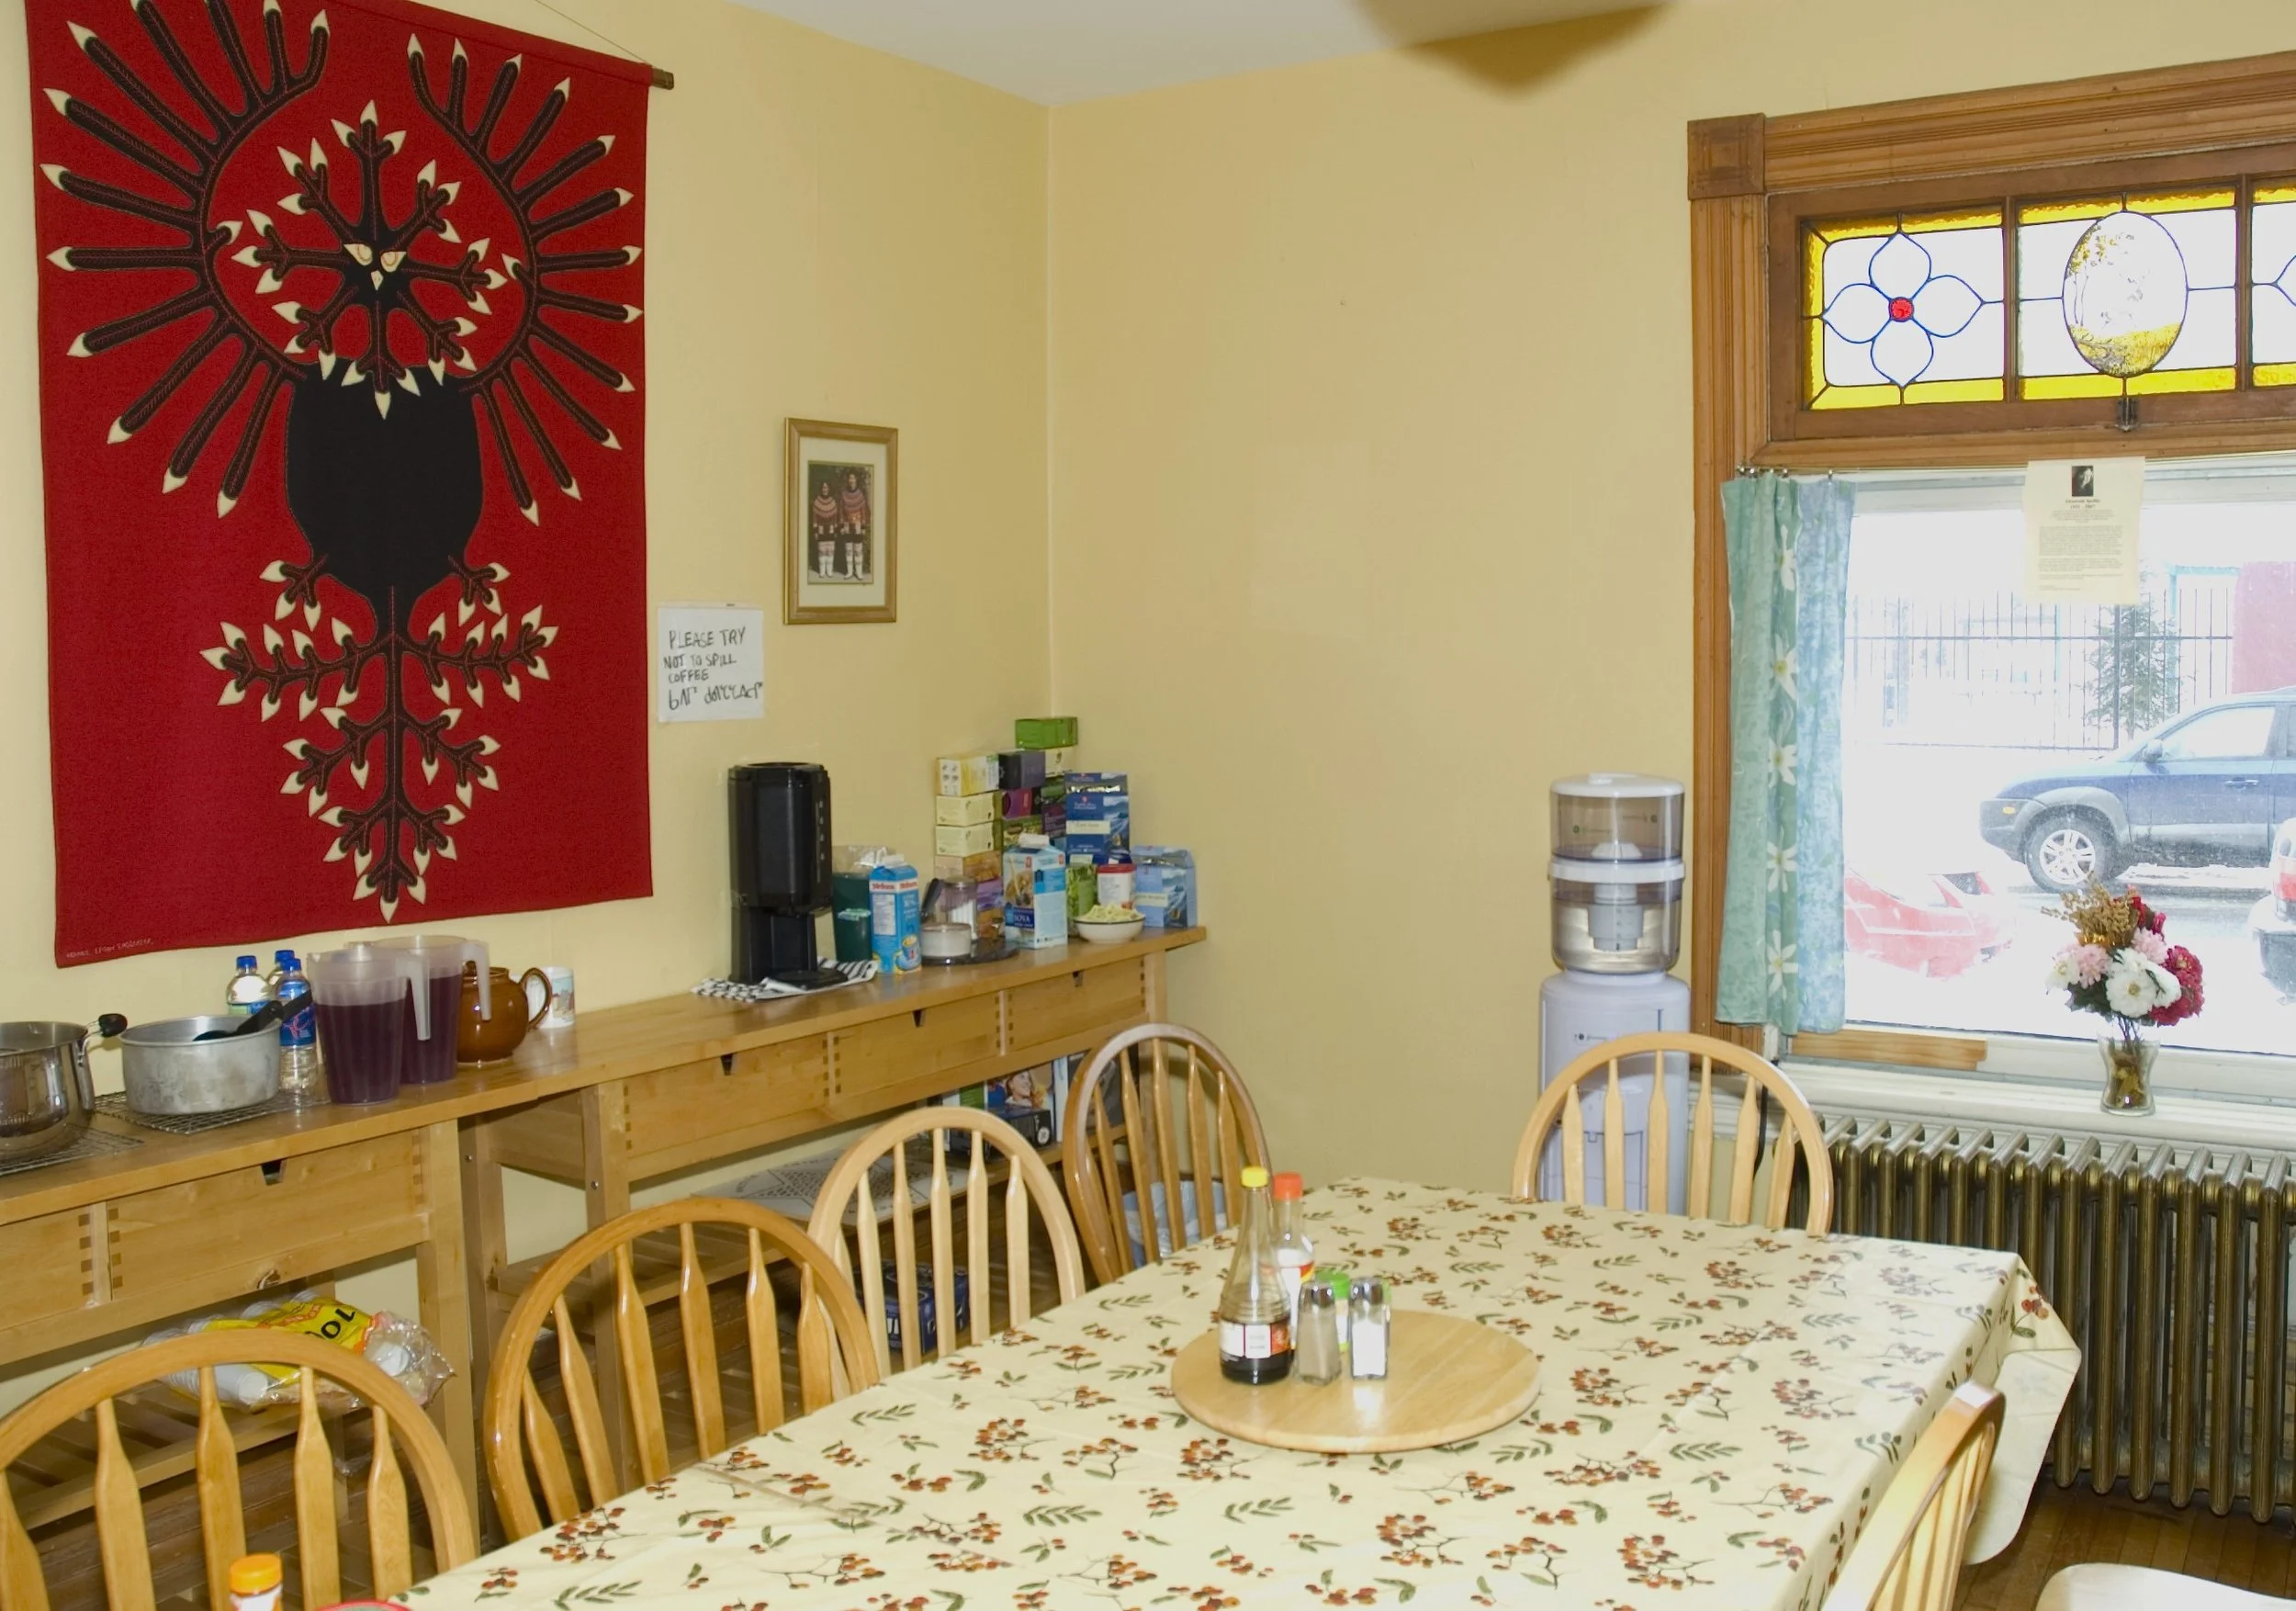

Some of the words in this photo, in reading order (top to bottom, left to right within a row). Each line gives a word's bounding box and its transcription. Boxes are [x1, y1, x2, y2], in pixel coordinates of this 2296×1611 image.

[669, 629, 715, 650] PLEASE
[719, 625, 747, 647] TRY
[663, 653, 685, 669] NOT
[691, 654, 703, 668] TO
[704, 652, 737, 668] SPILL
[668, 668, 709, 684] COFFEE
